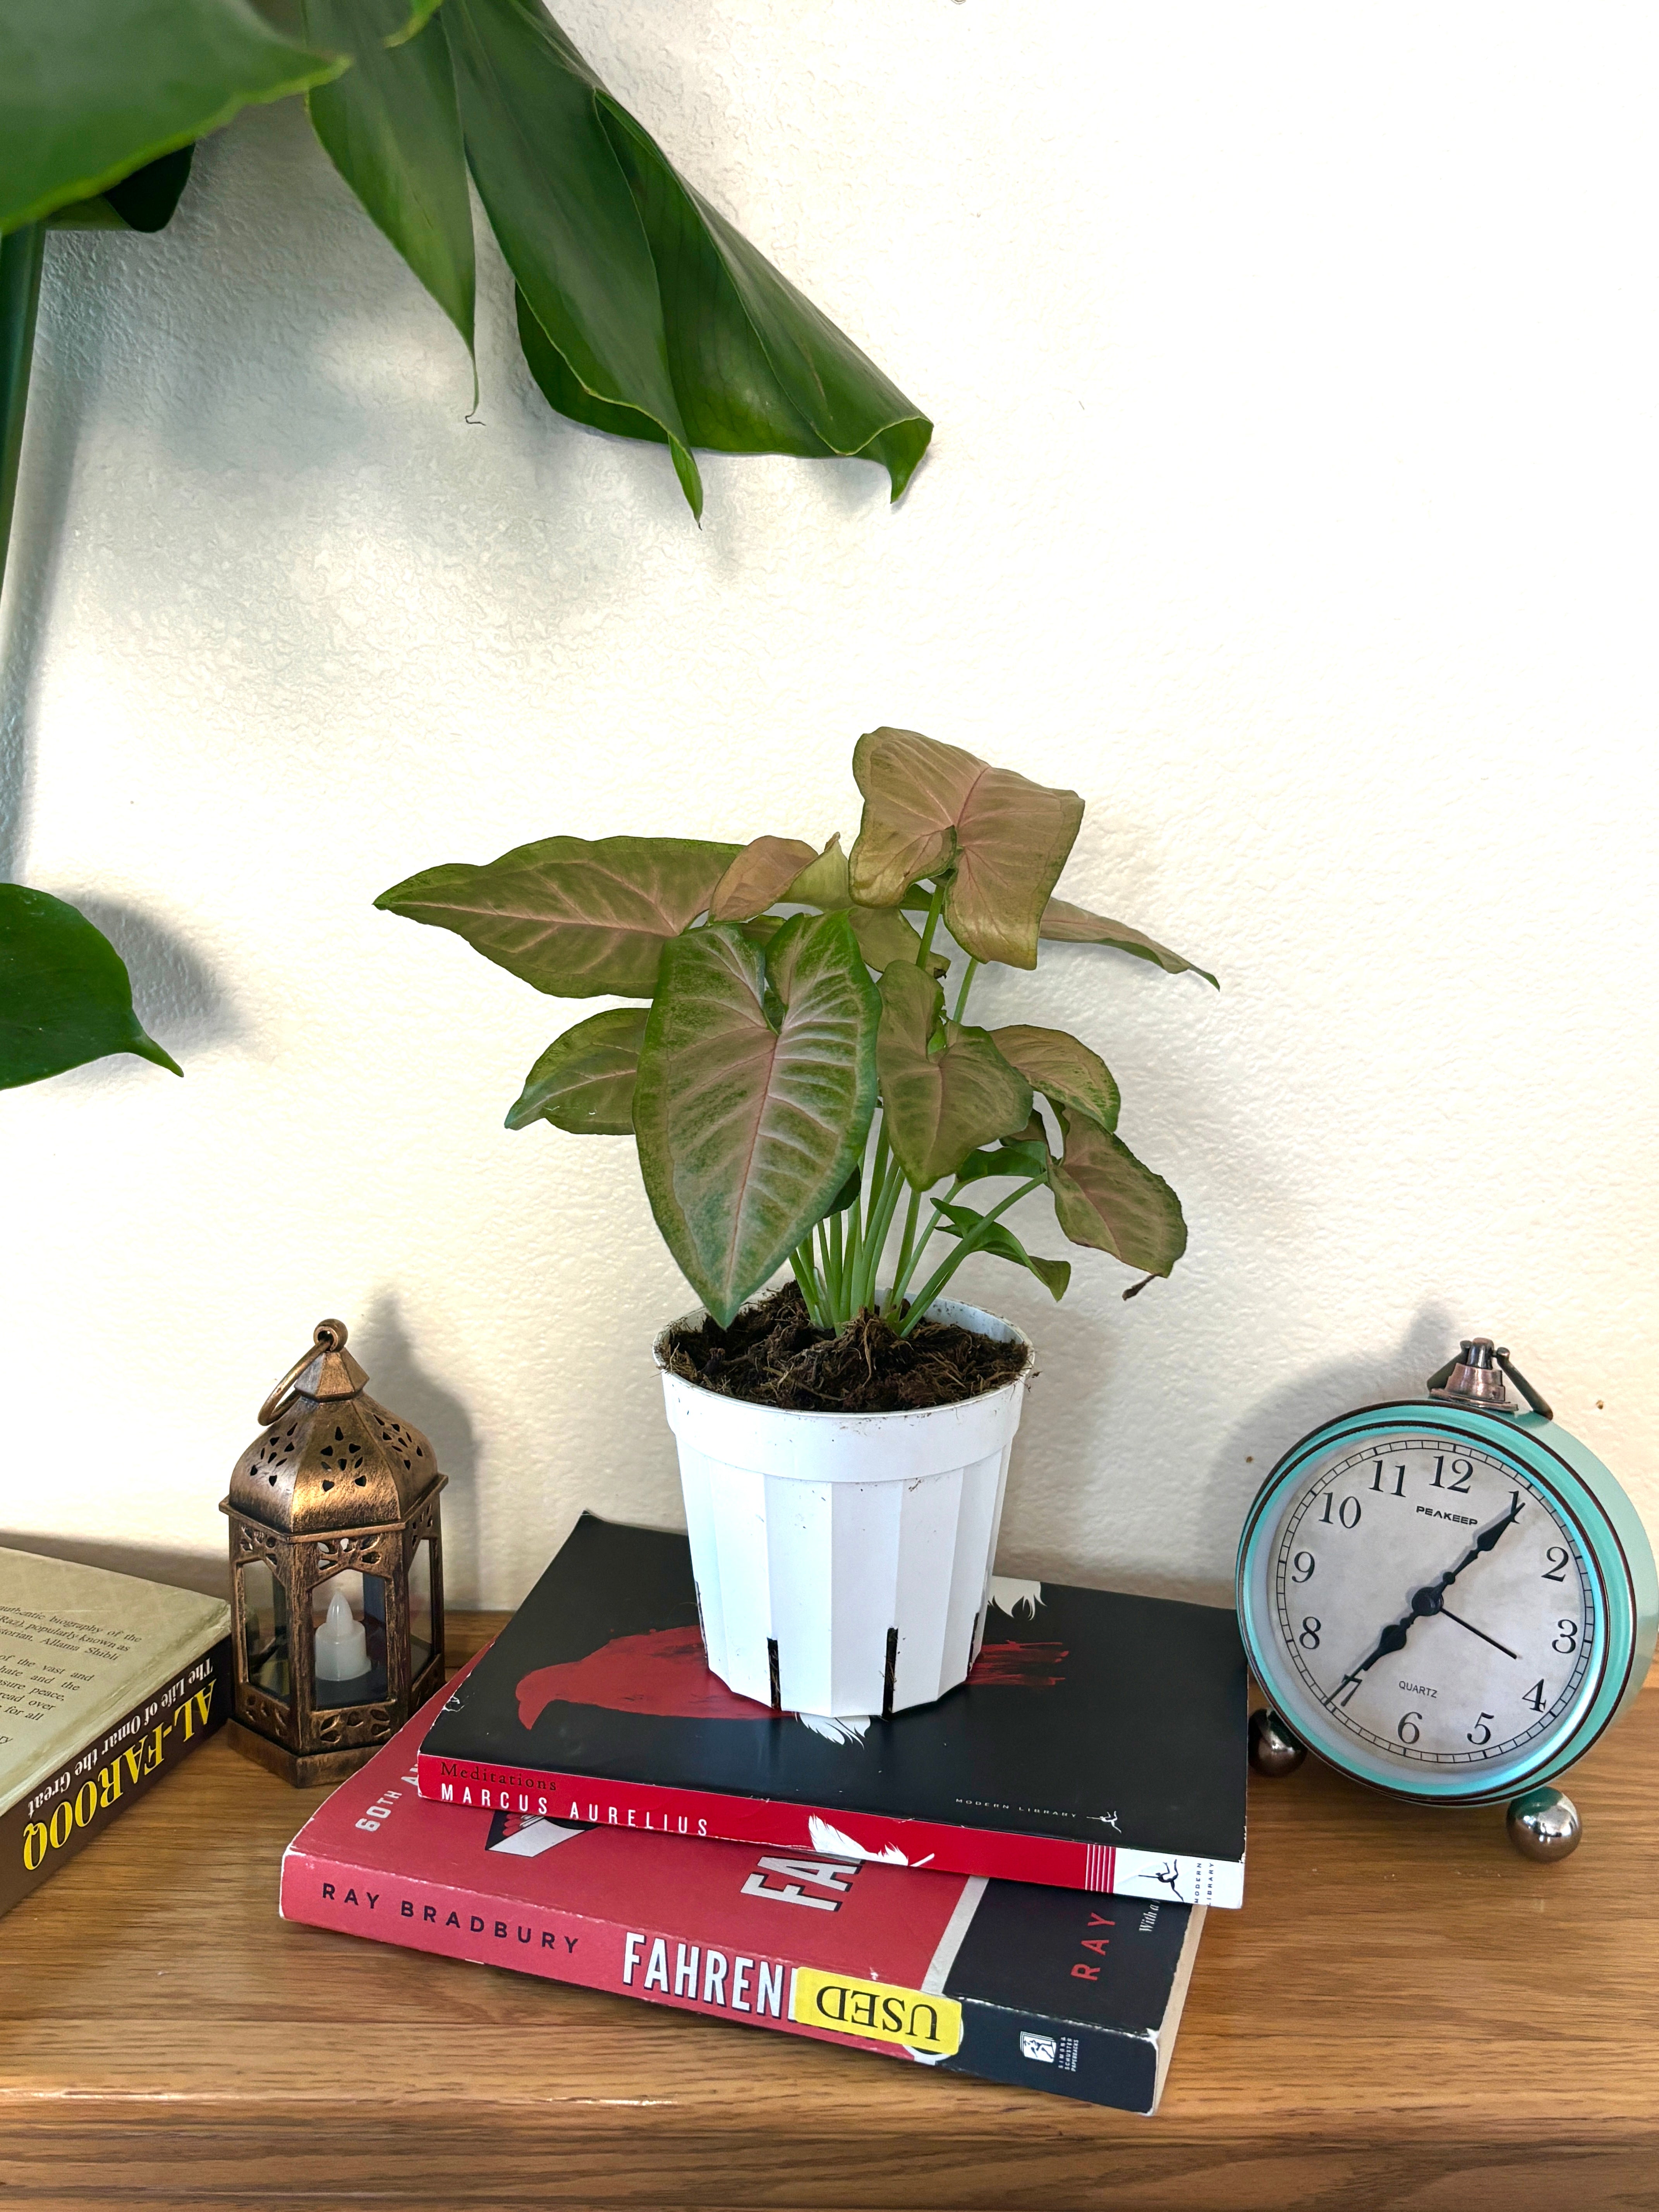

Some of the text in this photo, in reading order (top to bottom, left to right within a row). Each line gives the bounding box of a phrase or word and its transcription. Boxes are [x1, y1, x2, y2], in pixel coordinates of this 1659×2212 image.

[1369, 1459, 1406, 1498] 11
[1429, 1455, 1474, 1494] 12
[1319, 1492, 1362, 1529] 10
[1416, 1506, 1478, 1526] PEAKEEP
[1291, 1551, 1315, 1583] 9
[1541, 1547, 1569, 1582] 2
[25, 1623, 78, 1640] popularly
[79, 1634, 117, 1649] known
[50, 1615, 103, 1633] biography
[124, 1633, 142, 1643] the
[1299, 1616, 1321, 1650] 8
[1552, 1620, 1578, 1654] 3
[40, 1638, 80, 1652] Allama
[84, 1647, 121, 1661] Shibli
[17, 1658, 36, 1667] the
[42, 1665, 65, 1674] vast
[70, 1672, 95, 1682] and
[30, 1675, 55, 1684] and
[61, 1682, 80, 1691] the
[27, 1688, 65, 1701] peace,
[28, 1700, 56, 1711] over
[1399, 1681, 1437, 1698] QUARTZ
[1522, 1678, 1546, 1713] 4
[3, 1706, 24, 1715] for
[25, 1712, 44, 1721] all
[1398, 1712, 1422, 1743] 6
[1467, 1712, 1494, 1745] 5
[28, 1657, 213, 1819] The Life of Omar the Great
[23, 1678, 216, 1870] AL-FAROOQ
[440, 1761, 557, 1791] Meditations
[355, 1790, 403, 1832] 60TH
[441, 1783, 708, 1836] MARCUS AURELIUS
[956, 1798, 1076, 1818] MODERN LIBRARY
[1206, 1863, 1214, 1906] LIBRARY
[323, 1883, 579, 1954] RAY BRADBURY
[1139, 1911, 1157, 1932] With
[1070, 1912, 1116, 1981] RAY
[816, 1985, 940, 2042] USED
